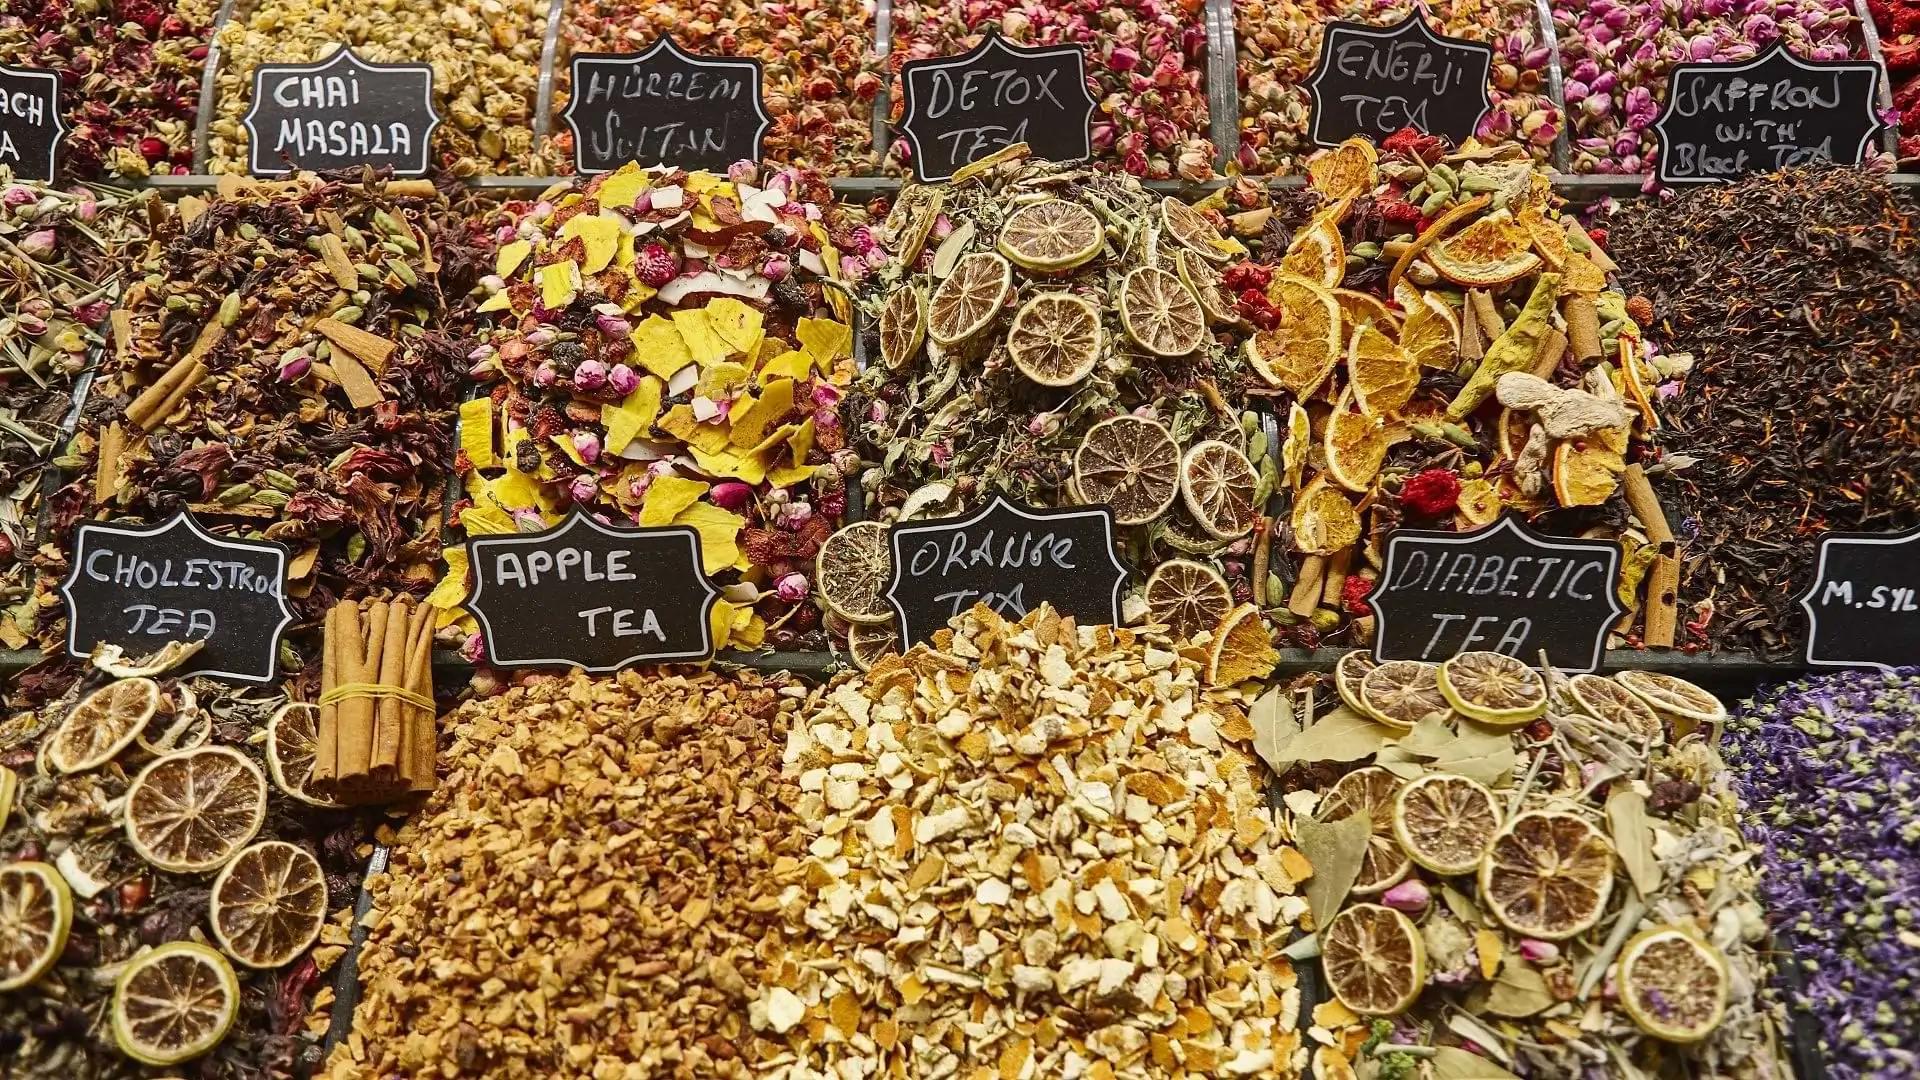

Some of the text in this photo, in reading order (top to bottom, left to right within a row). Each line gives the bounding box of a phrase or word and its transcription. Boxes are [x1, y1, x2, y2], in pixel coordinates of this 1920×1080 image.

[927, 69, 1065, 118] DETOX
[1675, 70, 1843, 117] SAFFRON
[1340, 94, 1429, 135] TEA
[274, 118, 410, 156] MASALA
[496, 547, 636, 588] APPLE
[1390, 551, 1604, 600] DIABETIC
[123, 604, 217, 639] TEA
[578, 606, 667, 642] TEA
